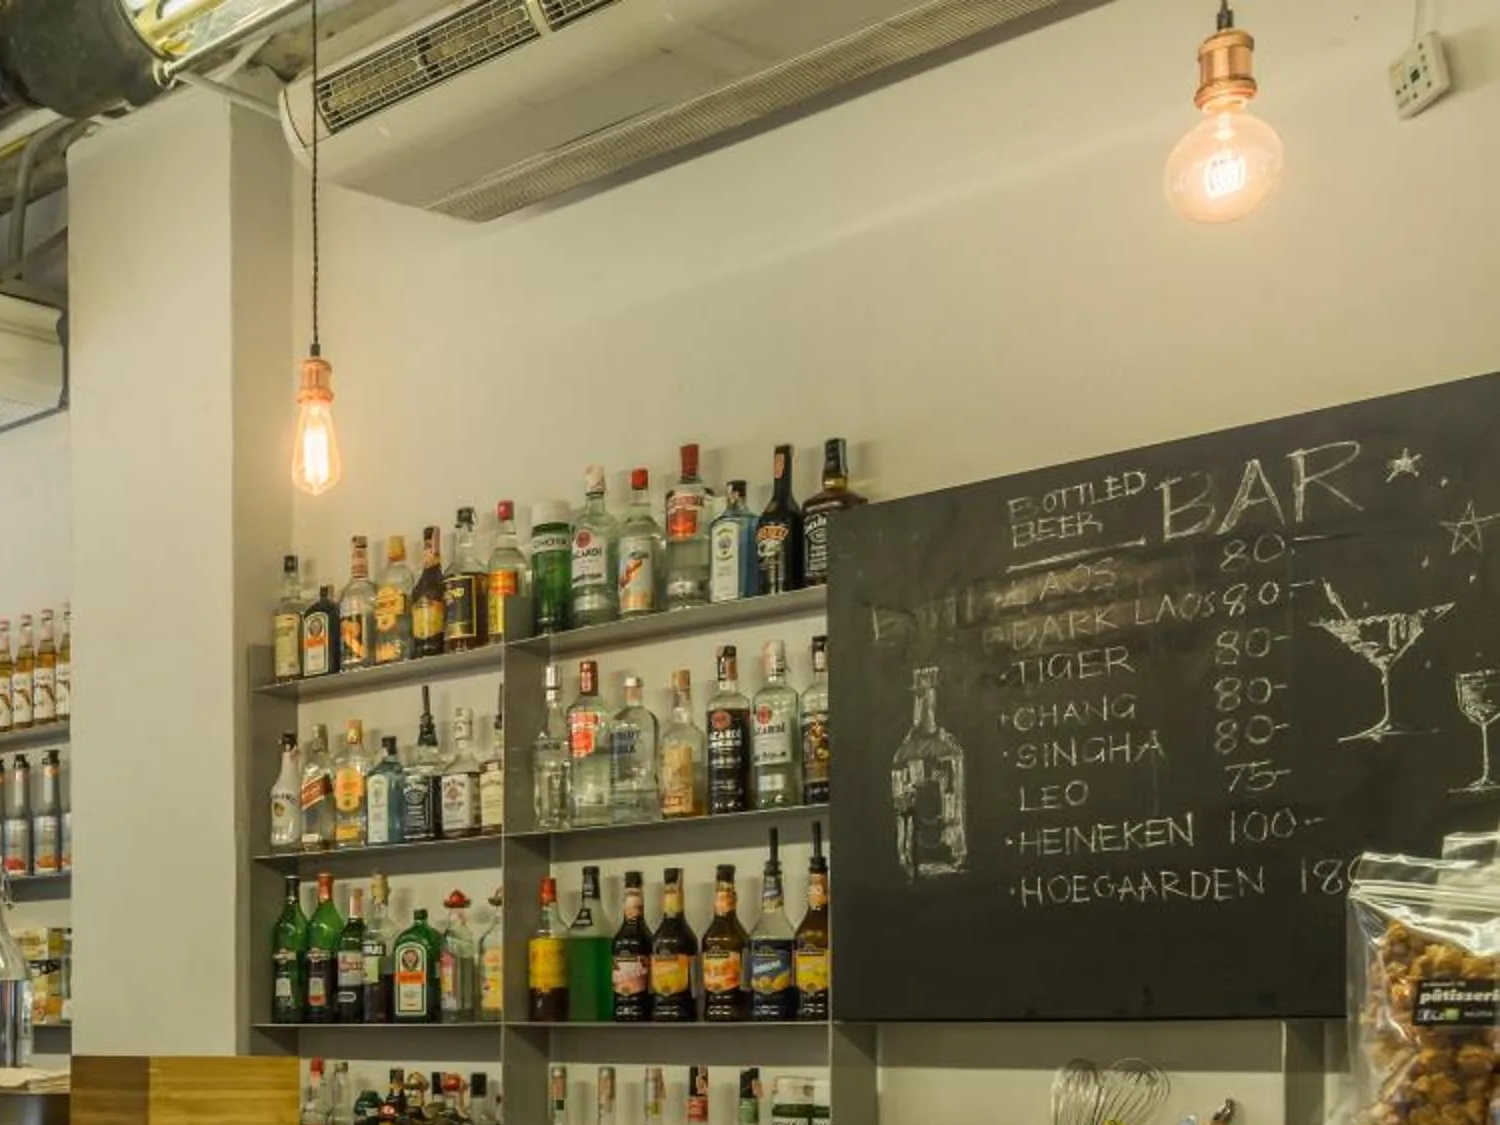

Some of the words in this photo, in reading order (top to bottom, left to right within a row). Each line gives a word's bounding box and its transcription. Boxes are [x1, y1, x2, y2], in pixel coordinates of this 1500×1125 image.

[1006, 471, 1148, 520] BOTTLED
[1155, 440, 1364, 544] BAR
[1010, 512, 1103, 550] BEER
[1011, 607, 1120, 652] DARK
[1133, 590, 1216, 626] LAOS
[1011, 647, 1137, 683] TIGER
[1012, 693, 1138, 732] CHANG
[1015, 730, 1168, 770] SINGHA
[1019, 780, 1090, 812] LEO
[1019, 812, 1195, 856] HEINEKEN
[1020, 866, 1265, 908] HOEGAARDEN
